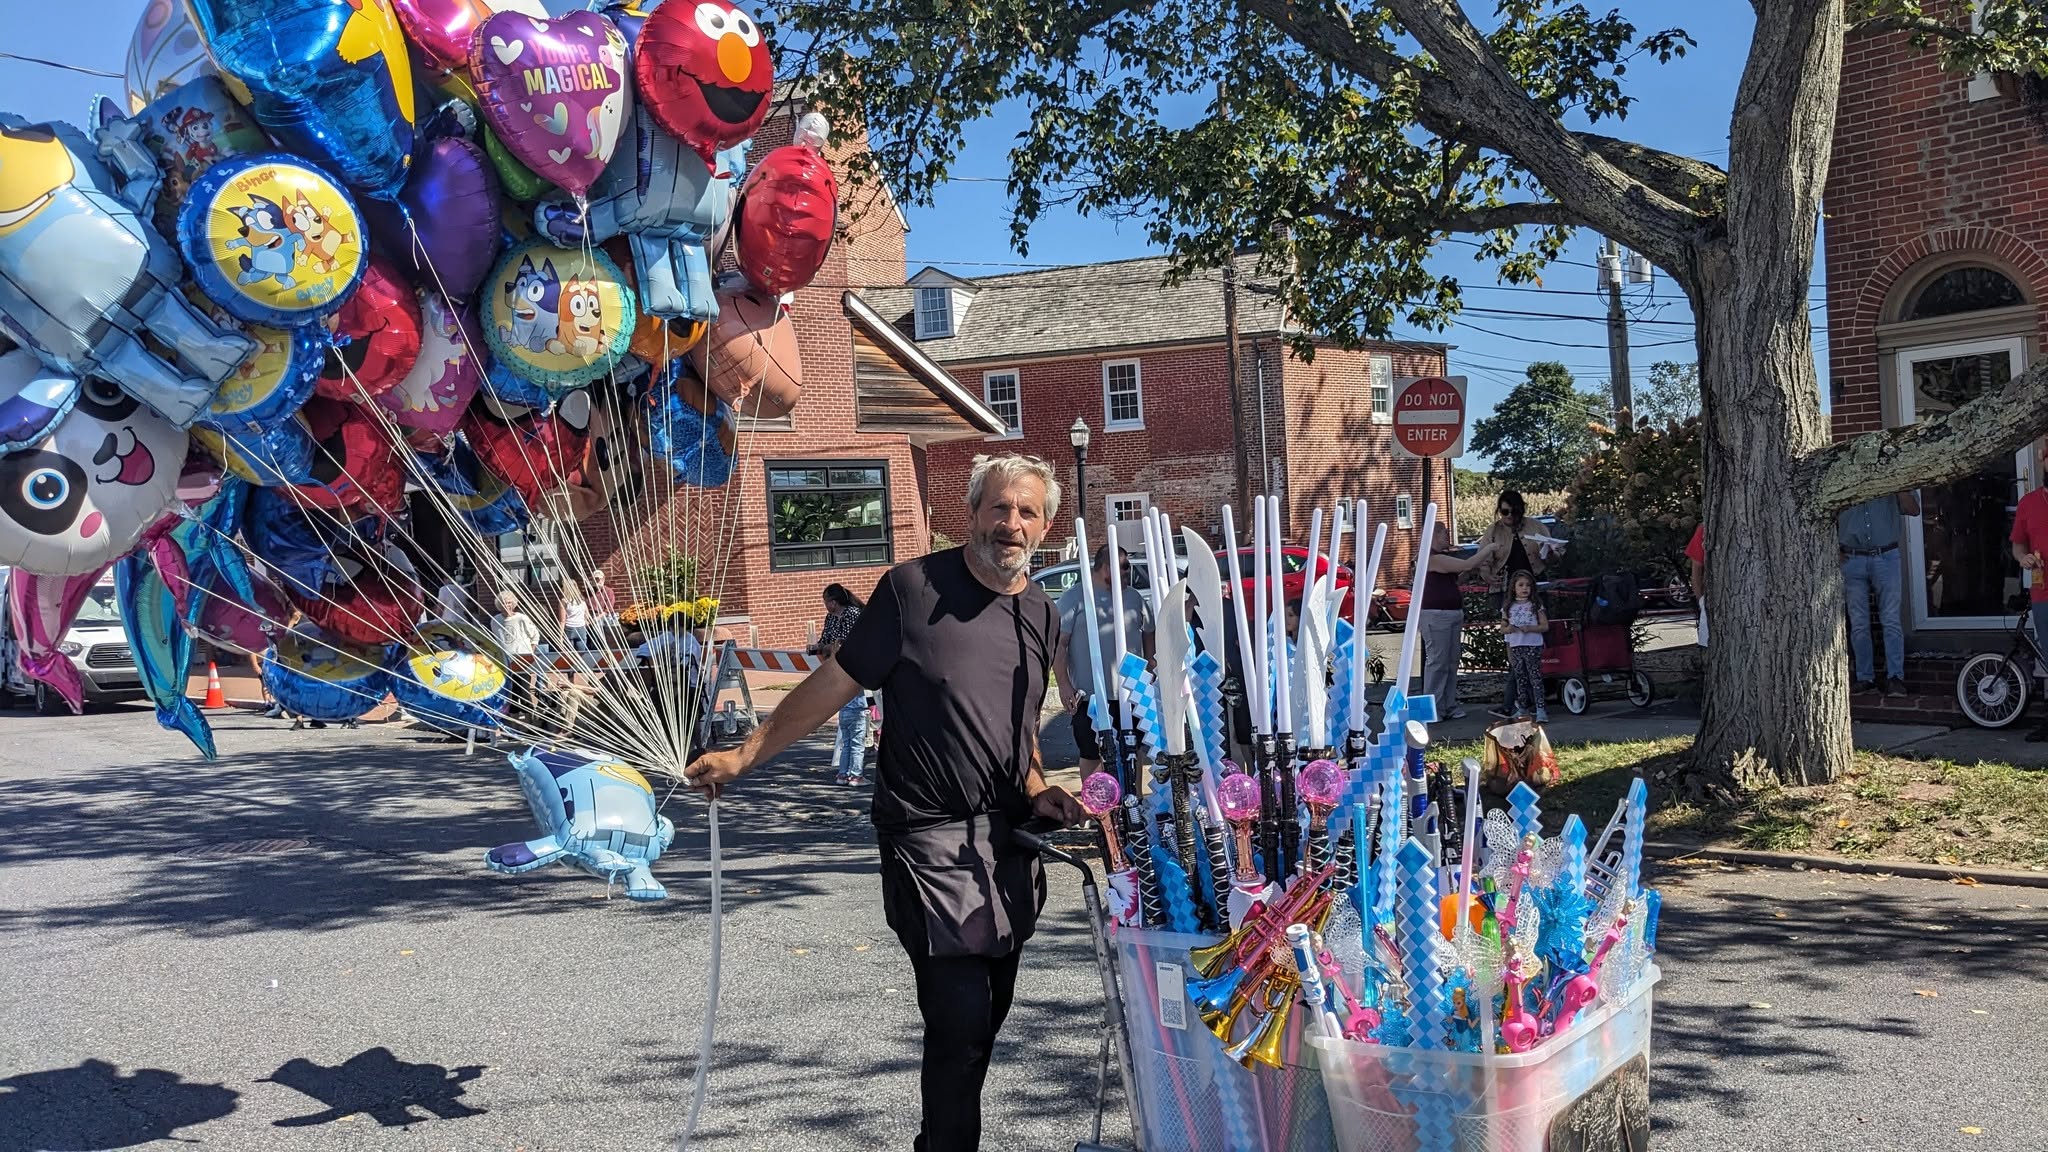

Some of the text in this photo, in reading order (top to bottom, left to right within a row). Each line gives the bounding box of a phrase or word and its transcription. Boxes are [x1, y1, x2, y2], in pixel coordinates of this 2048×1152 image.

[523, 62, 613, 96] MAGICAL
[1405, 393, 1455, 406] DO NOT
[1407, 428, 1448, 441] ENTER
